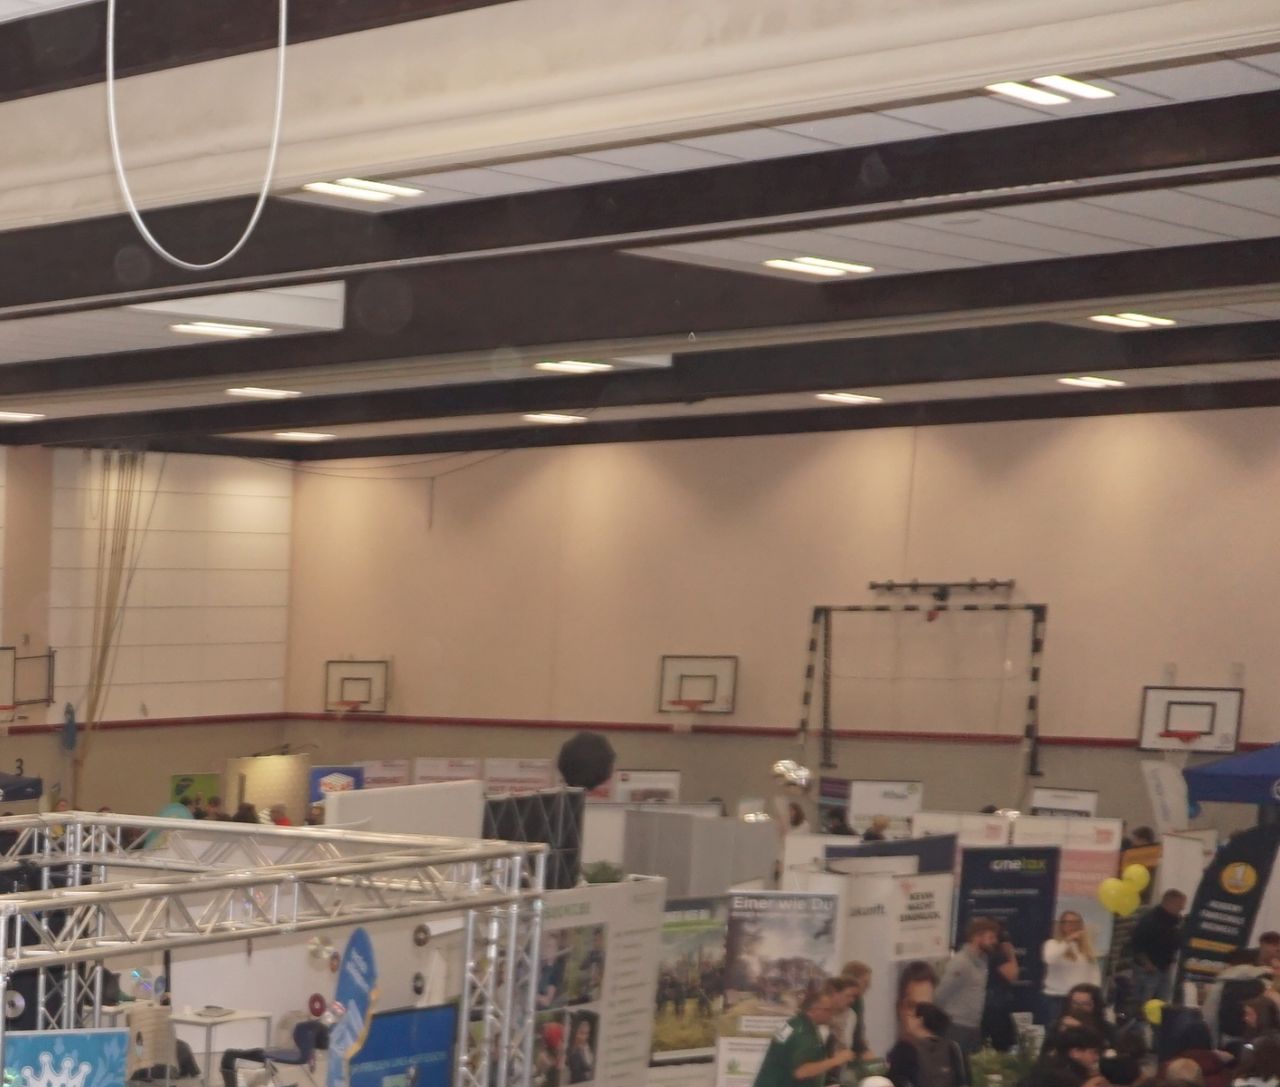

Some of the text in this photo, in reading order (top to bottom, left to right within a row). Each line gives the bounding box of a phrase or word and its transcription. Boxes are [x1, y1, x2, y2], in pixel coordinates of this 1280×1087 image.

[733, 897, 833, 911] Einer wie Du
